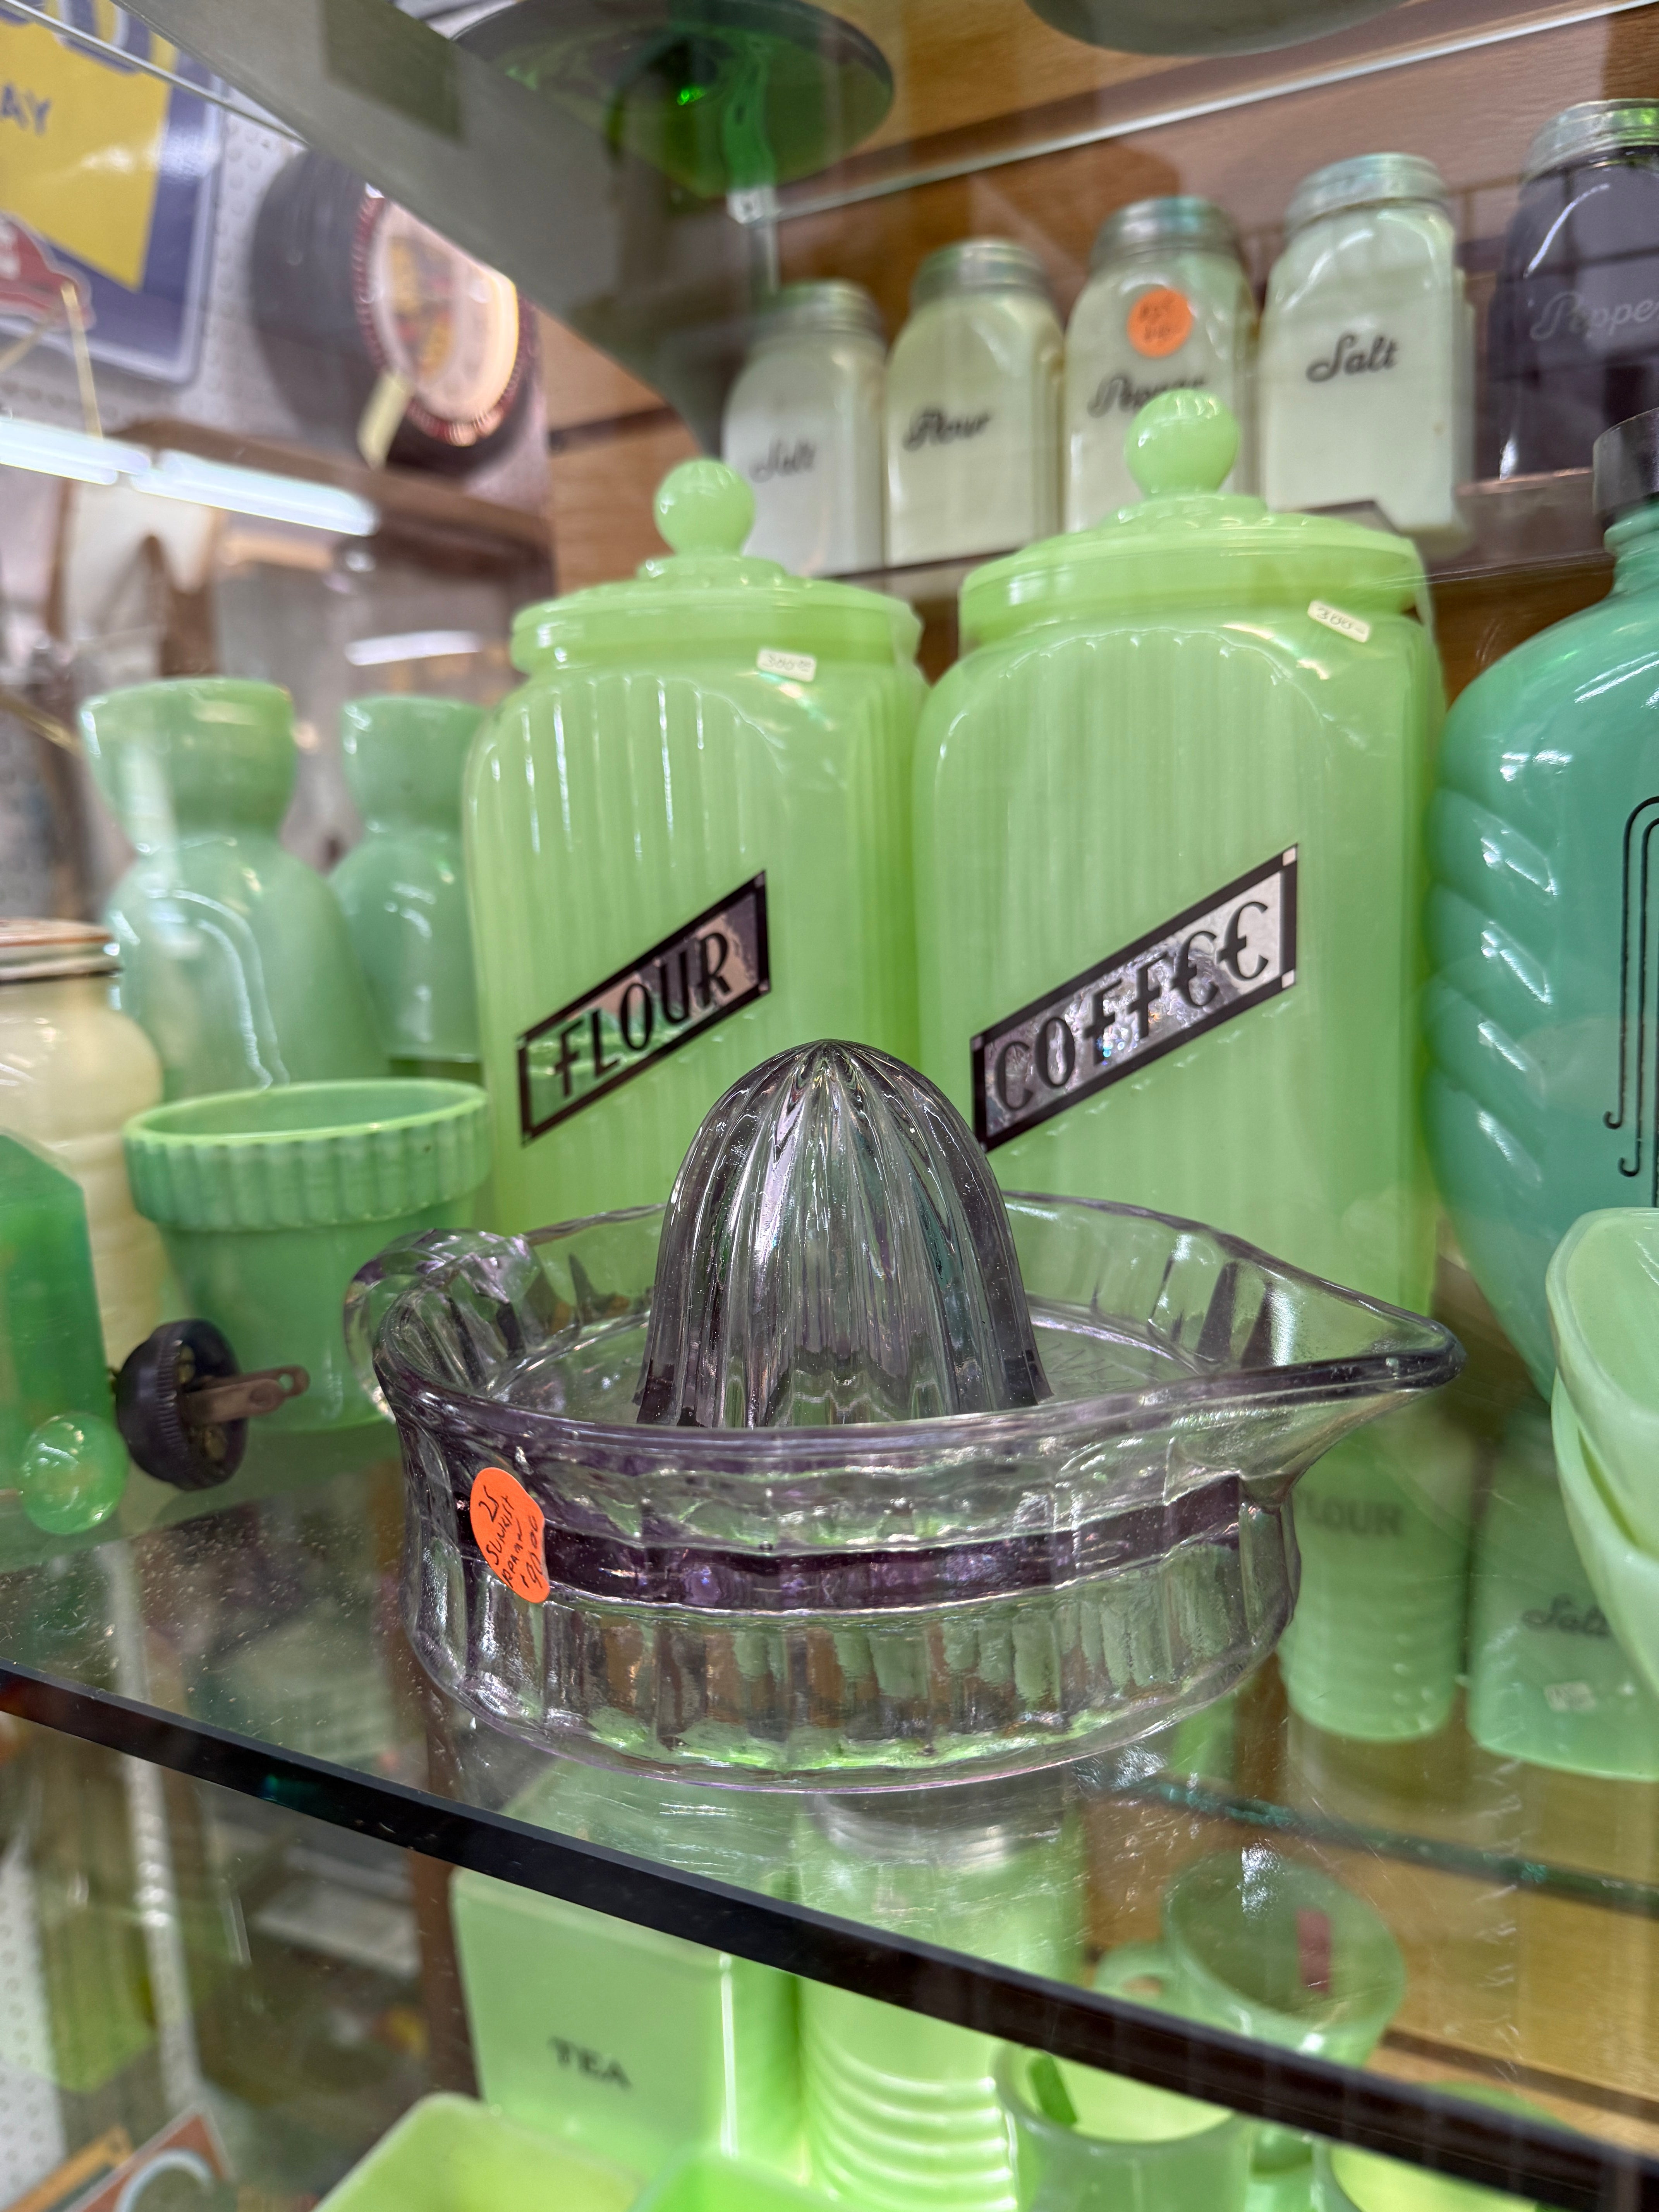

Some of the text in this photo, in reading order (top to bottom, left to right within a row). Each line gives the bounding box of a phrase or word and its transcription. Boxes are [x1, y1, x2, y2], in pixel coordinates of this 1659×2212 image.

[1305, 334, 1397, 383] Salt
[555, 932, 731, 1097] FLOUR
[994, 901, 1269, 1110] COFFEE
[486, 1494, 515, 1566] SUNKIST
[1294, 1491, 1404, 1537] LOUR
[546, 2036, 633, 2090] TEA
